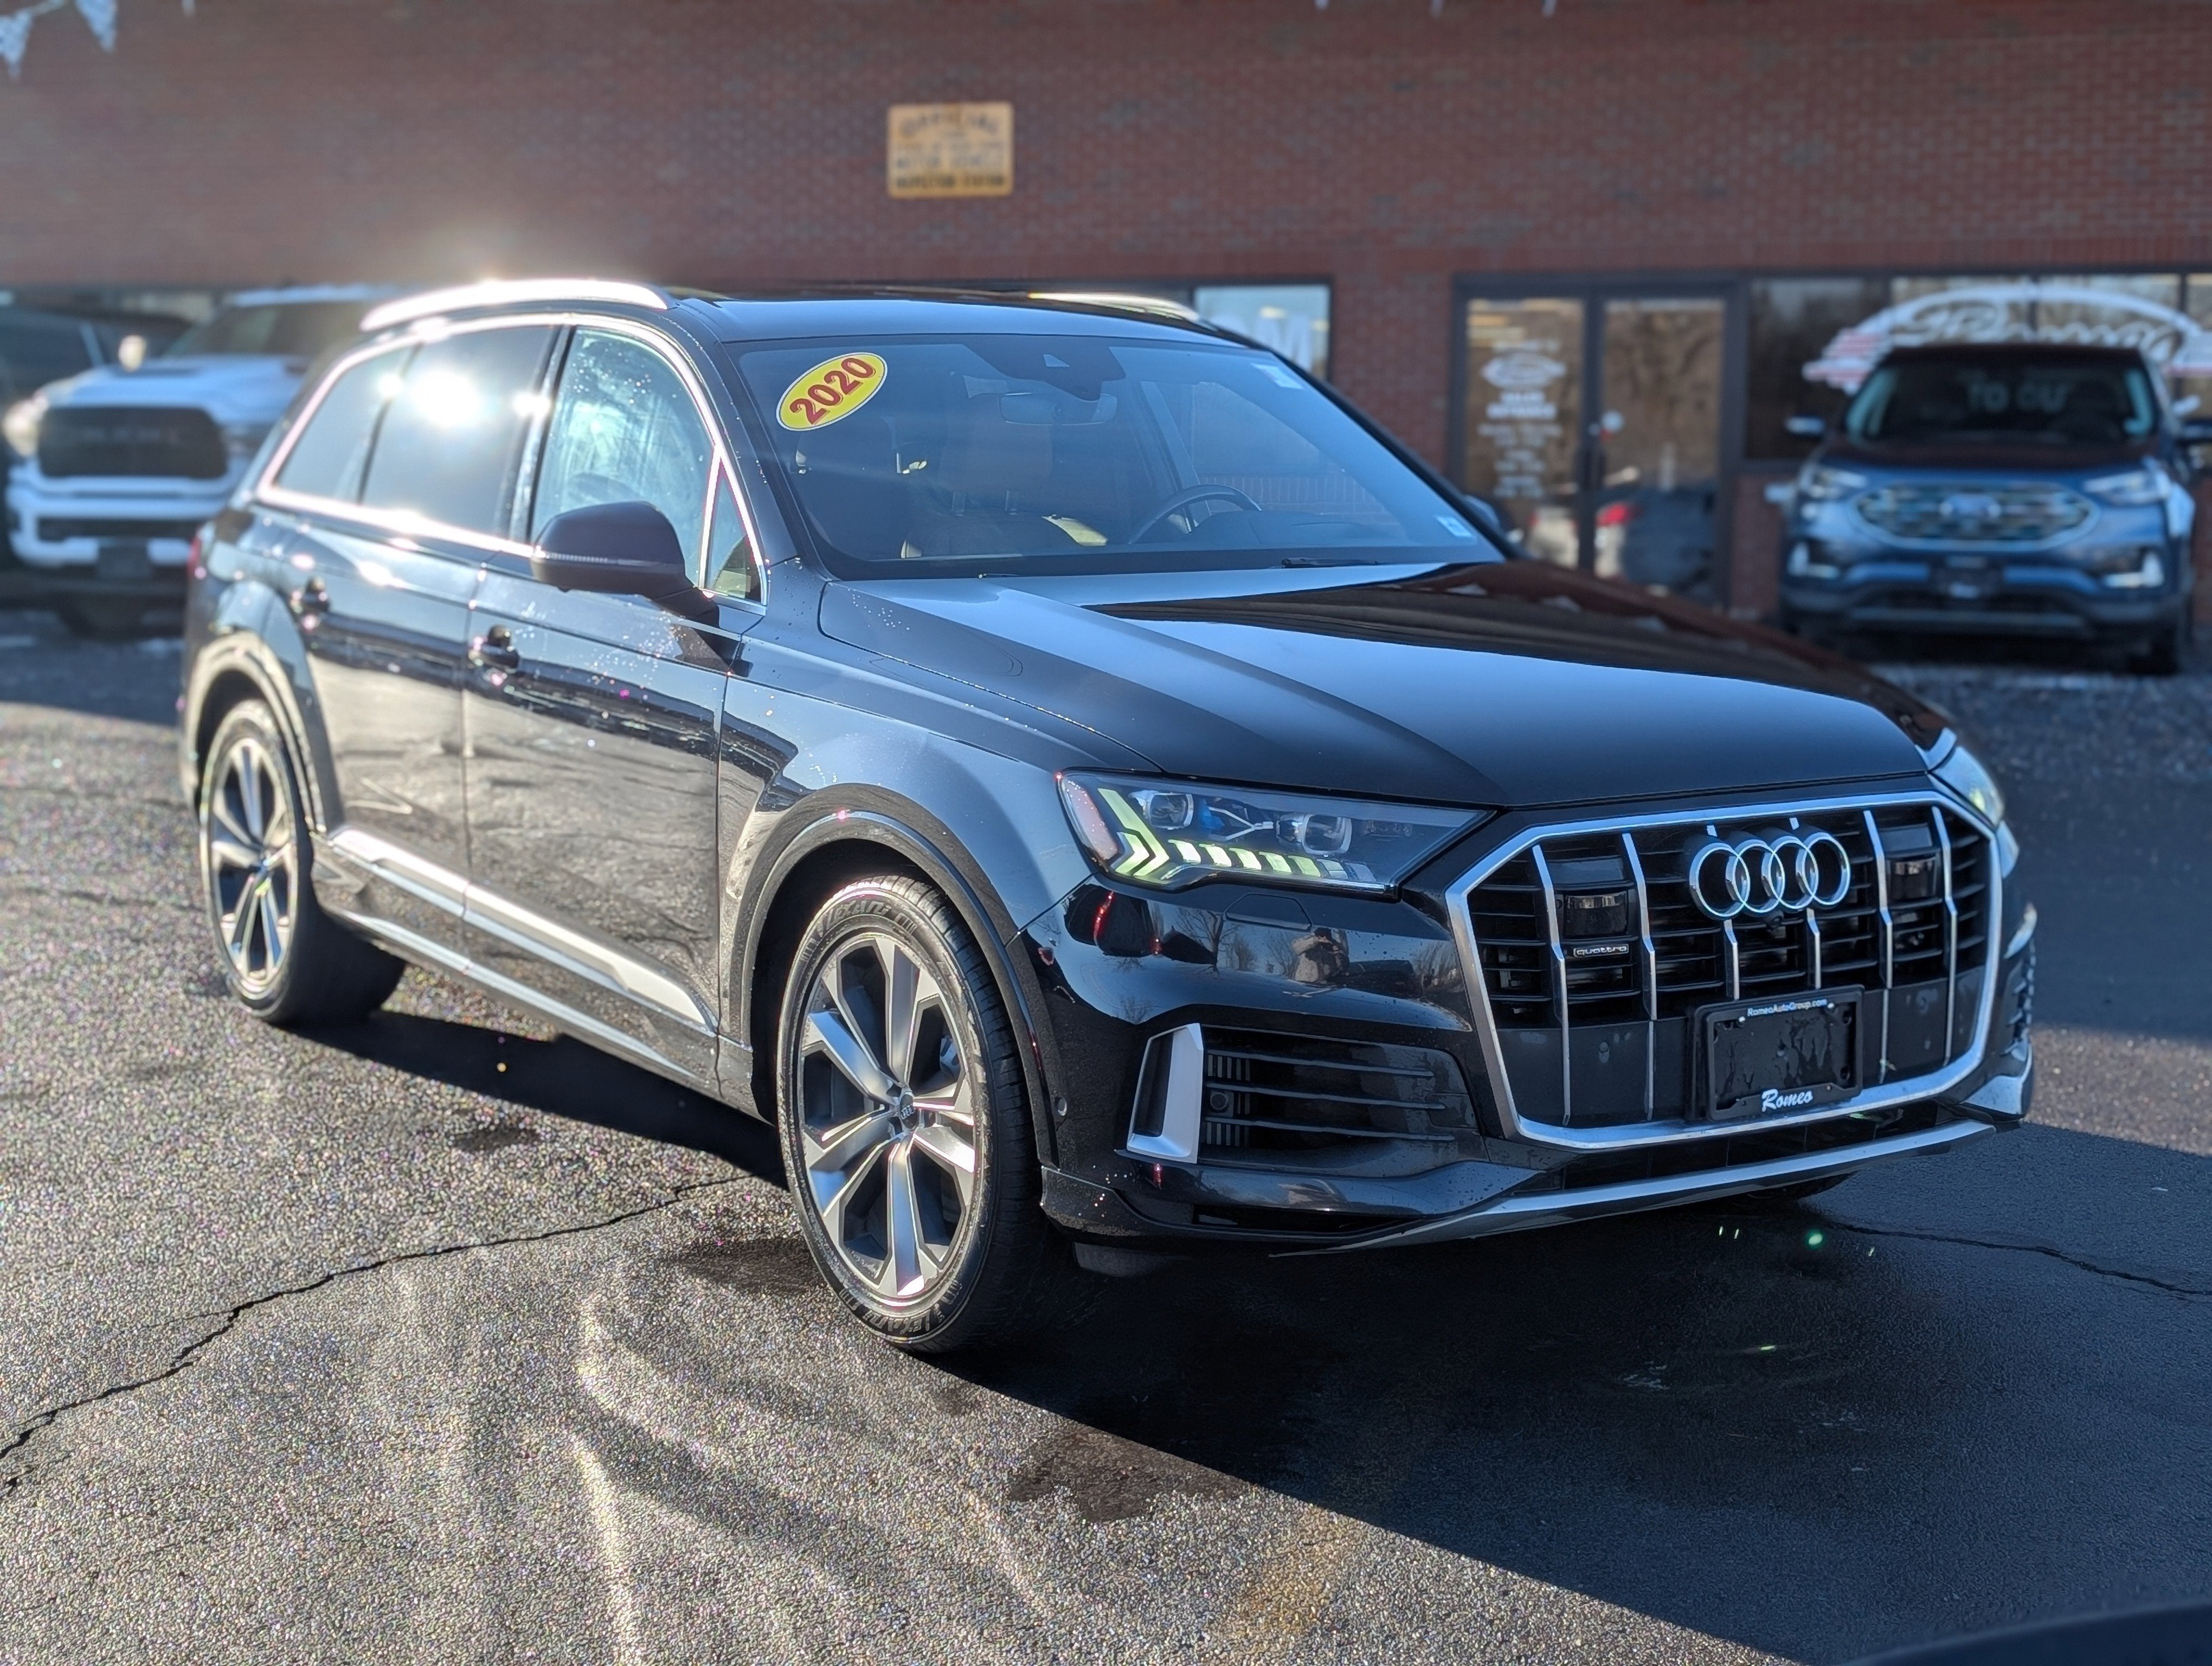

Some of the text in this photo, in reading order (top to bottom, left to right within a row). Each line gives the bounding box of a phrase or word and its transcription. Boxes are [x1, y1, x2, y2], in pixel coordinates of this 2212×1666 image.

[789, 357, 876, 425] 2020
[1577, 946, 1627, 956] quattro
[1761, 1088, 1813, 1112] Romeo
